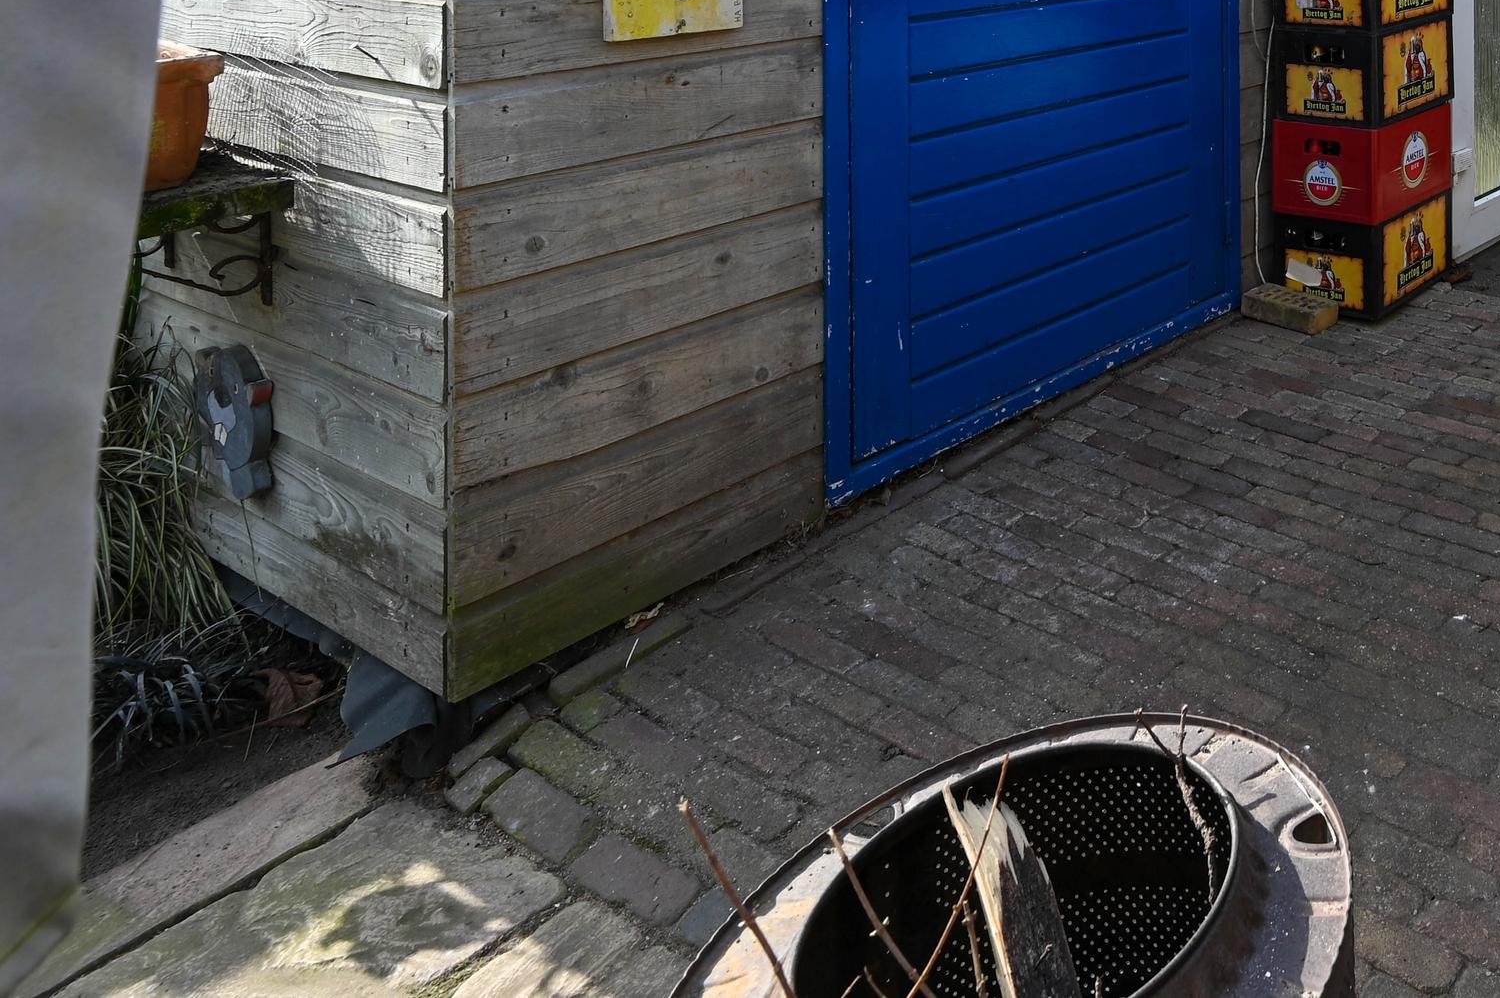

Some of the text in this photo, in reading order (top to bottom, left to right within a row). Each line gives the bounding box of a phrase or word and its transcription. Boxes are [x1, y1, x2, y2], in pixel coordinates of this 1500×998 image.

[1305, 9, 1342, 19] Hertog Jan
[1400, 79, 1433, 99] Hertog Jan
[1306, 100, 1344, 112] Hertog Jan
[1406, 149, 1424, 163] AMSTEL
[1310, 175, 1335, 185] AMSTEL
[1400, 259, 1432, 285] Hertog Jan
[1330, 290, 1343, 300] Jan
